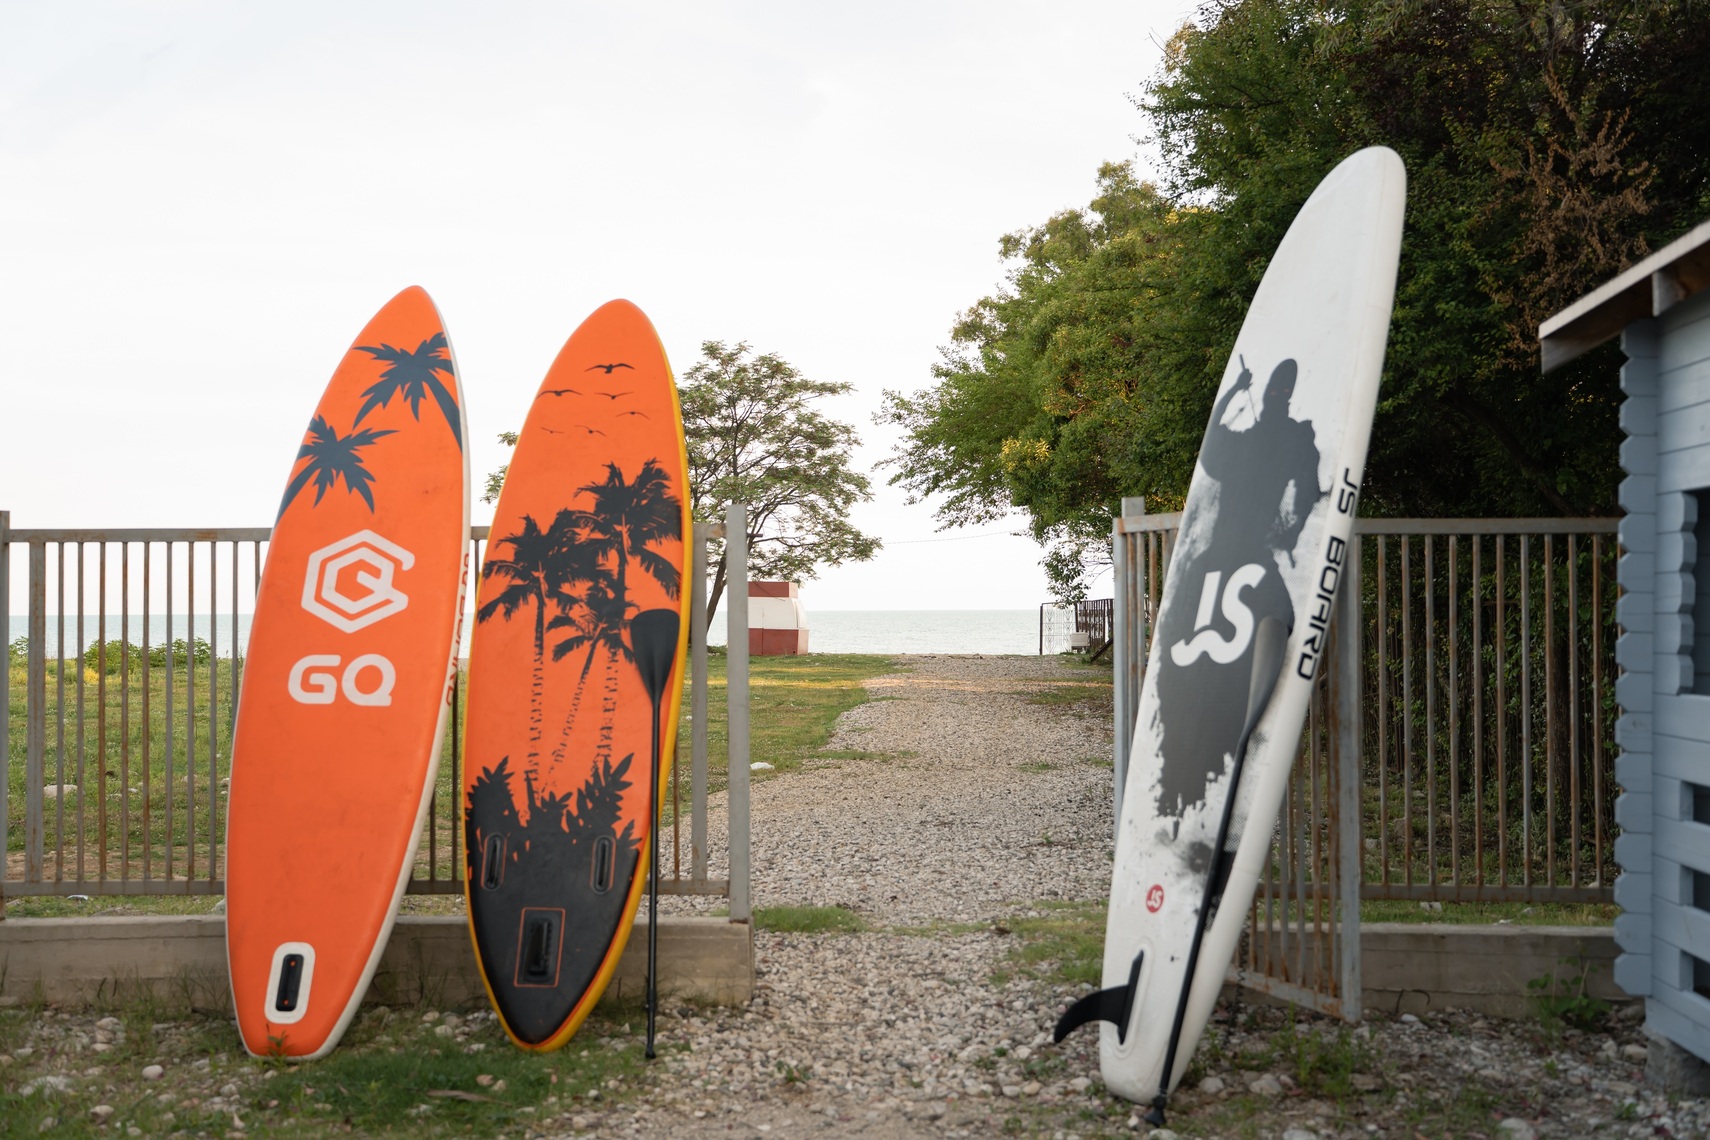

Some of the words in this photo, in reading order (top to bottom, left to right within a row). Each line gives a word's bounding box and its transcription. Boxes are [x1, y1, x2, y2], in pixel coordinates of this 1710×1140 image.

[1336, 467, 1359, 517] JS
[1296, 535, 1346, 681] BOARD
[287, 653, 397, 707] GQ
